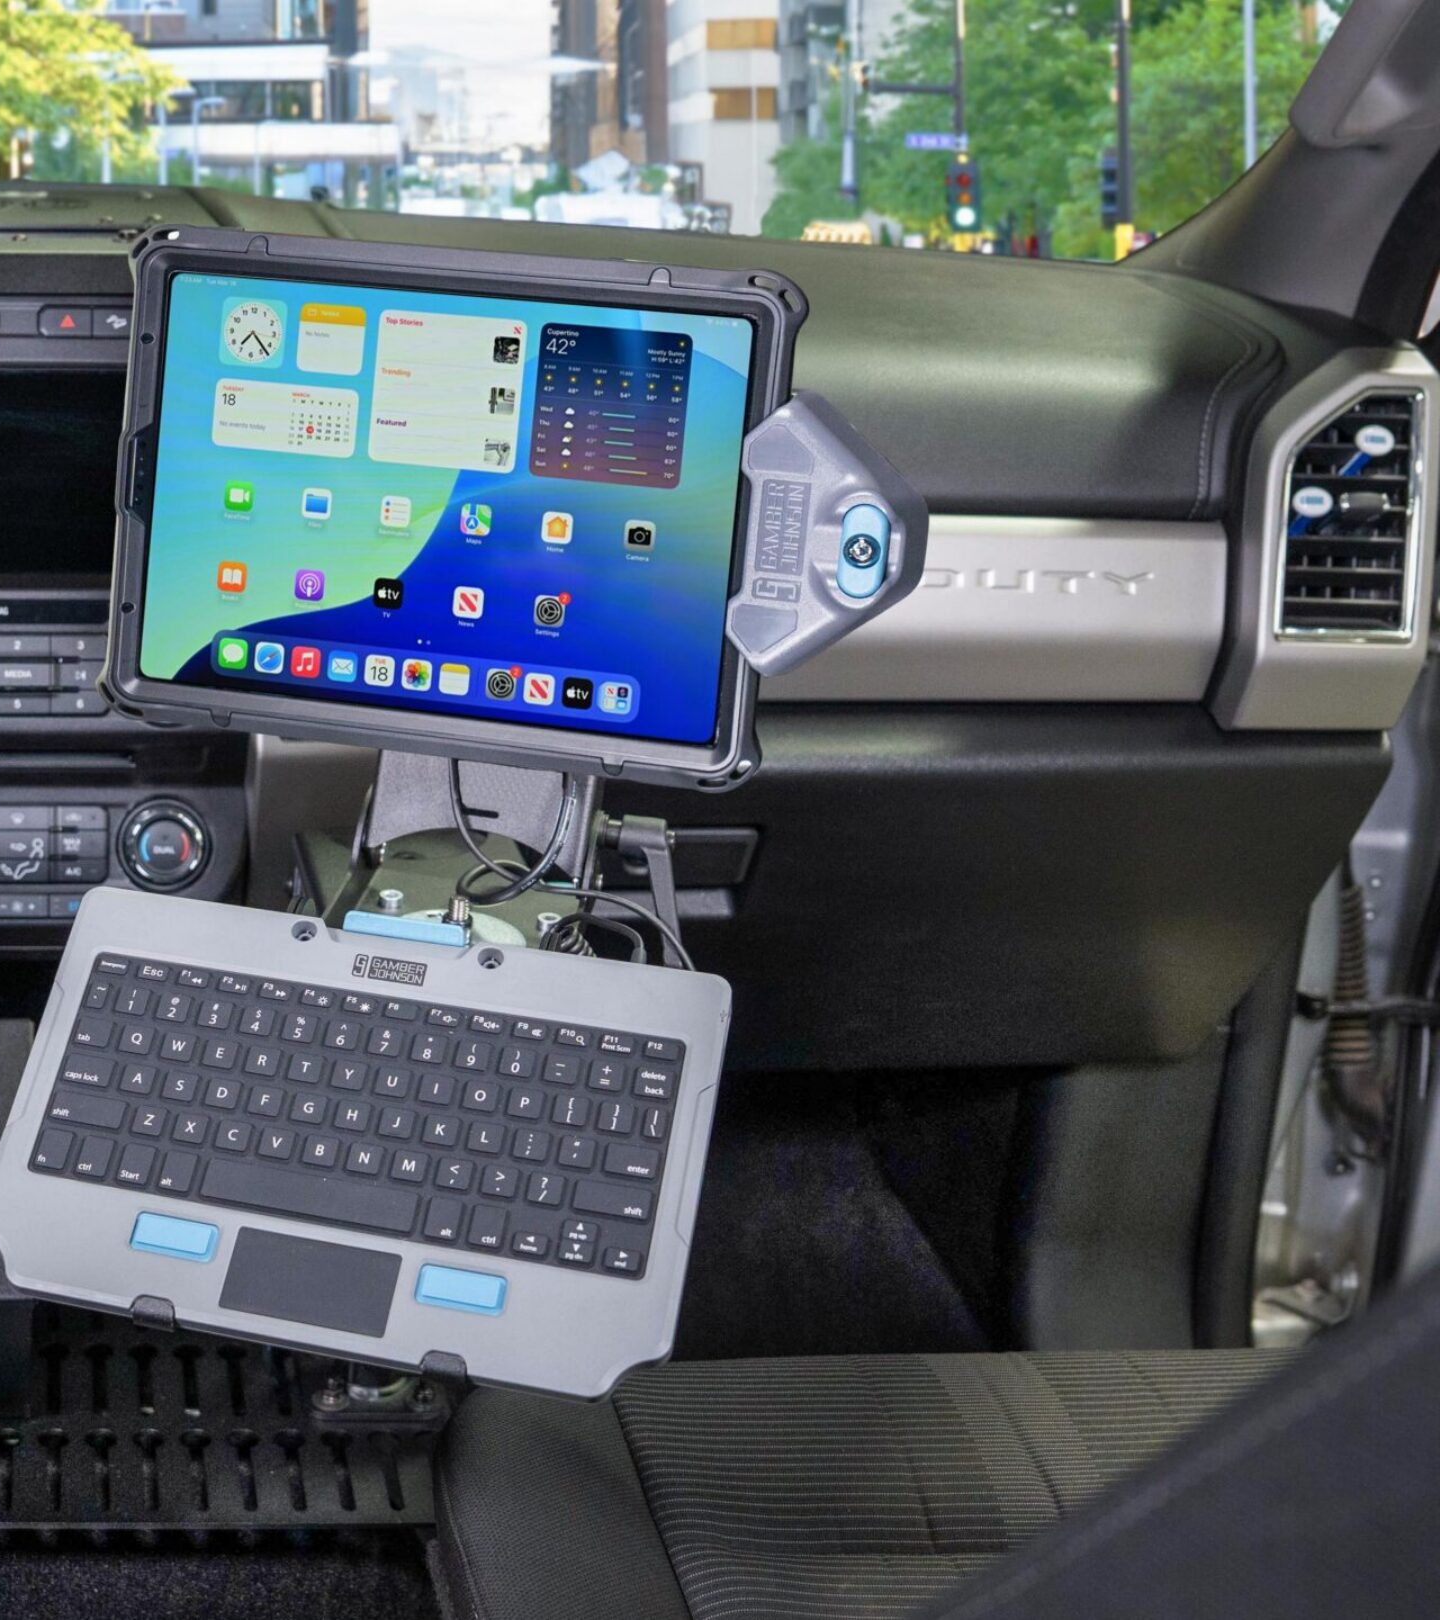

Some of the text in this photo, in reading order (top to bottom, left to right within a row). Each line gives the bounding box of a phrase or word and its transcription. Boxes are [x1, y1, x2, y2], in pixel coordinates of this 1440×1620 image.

[386, 317, 423, 327] Top Stories
[547, 328, 579, 337] Cupertino
[546, 338, 577, 355] 42°
[648, 348, 686, 358] Mostly Sunny
[381, 367, 411, 377] Trending
[222, 393, 236, 406] 18
[377, 418, 407, 427] Featured
[761, 482, 785, 570] GAMBER
[780, 484, 805, 573] JOHNSON
[626, 554, 649, 562] Camera
[387, 589, 400, 600] tv
[458, 620, 474, 628] News
[535, 628, 559, 637] Settings
[13, 640, 22, 650] 2
[76, 640, 85, 650] 3
[4, 670, 32, 679] MEDIA
[371, 666, 388, 682] 18
[576, 688, 589, 699] tv
[13, 699, 22, 709] 5
[76, 699, 85, 709] 6
[65, 867, 81, 876] A/C
[142, 965, 164, 977] Esc
[372, 959, 425, 974] GAMBER
[222, 976, 233, 984] F2
[369, 967, 423, 984] JOHNSON
[263, 982, 274, 991] F3
[304, 989, 315, 997] F4
[346, 996, 358, 1004] F5
[127, 1001, 134, 1011] 1
[167, 1007, 176, 1018] 2
[431, 1009, 442, 1017] F7
[208, 1014, 217, 1025] 3
[473, 1015, 484, 1024] F8
[250, 1021, 259, 1032] 4
[517, 1022, 528, 1030] F9
[77, 1033, 91, 1042] tab
[293, 1028, 302, 1038] 5
[560, 1028, 575, 1037] F10
[131, 1033, 143, 1045] Q
[336, 1035, 345, 1046] 6
[604, 1035, 619, 1043] F11
[172, 1040, 186, 1052] W
[380, 1042, 389, 1053] 7
[647, 1041, 663, 1050] F12
[216, 1047, 225, 1059] E
[422, 1049, 432, 1059] 8
[257, 1055, 267, 1066] R
[466, 1055, 476, 1066] 9
[302, 1061, 311, 1073] T
[511, 1062, 520, 1073] 0
[65, 1071, 99, 1082] caps lock
[131, 1073, 142, 1084] A
[345, 1069, 355, 1080] Y
[641, 1071, 666, 1081] delete
[175, 1080, 185, 1091] S
[387, 1076, 398, 1087] U
[216, 1087, 228, 1098] D
[433, 1083, 439, 1094] I
[644, 1086, 664, 1095] back
[260, 1094, 270, 1105] F
[475, 1090, 486, 1101] O
[303, 1102, 315, 1114] G
[520, 1097, 530, 1108] P
[52, 1107, 70, 1117] shift
[346, 1109, 358, 1121] H
[143, 1114, 155, 1125] Z
[392, 1116, 401, 1128] J
[185, 1121, 196, 1133] X
[435, 1123, 446, 1136] K
[228, 1129, 239, 1141] C
[480, 1131, 489, 1143] L
[272, 1136, 283, 1148] V
[314, 1144, 324, 1156] B
[37, 1154, 46, 1163] fn
[358, 1152, 370, 1163] N
[78, 1162, 92, 1171] ctrl
[402, 1159, 416, 1172] M
[627, 1165, 650, 1174] enter
[120, 1169, 140, 1180] Start
[161, 1177, 172, 1186] alt
[624, 1207, 642, 1216] shift
[440, 1228, 452, 1237] alt
[482, 1235, 496, 1244] ctrl
[520, 1244, 538, 1252] home
